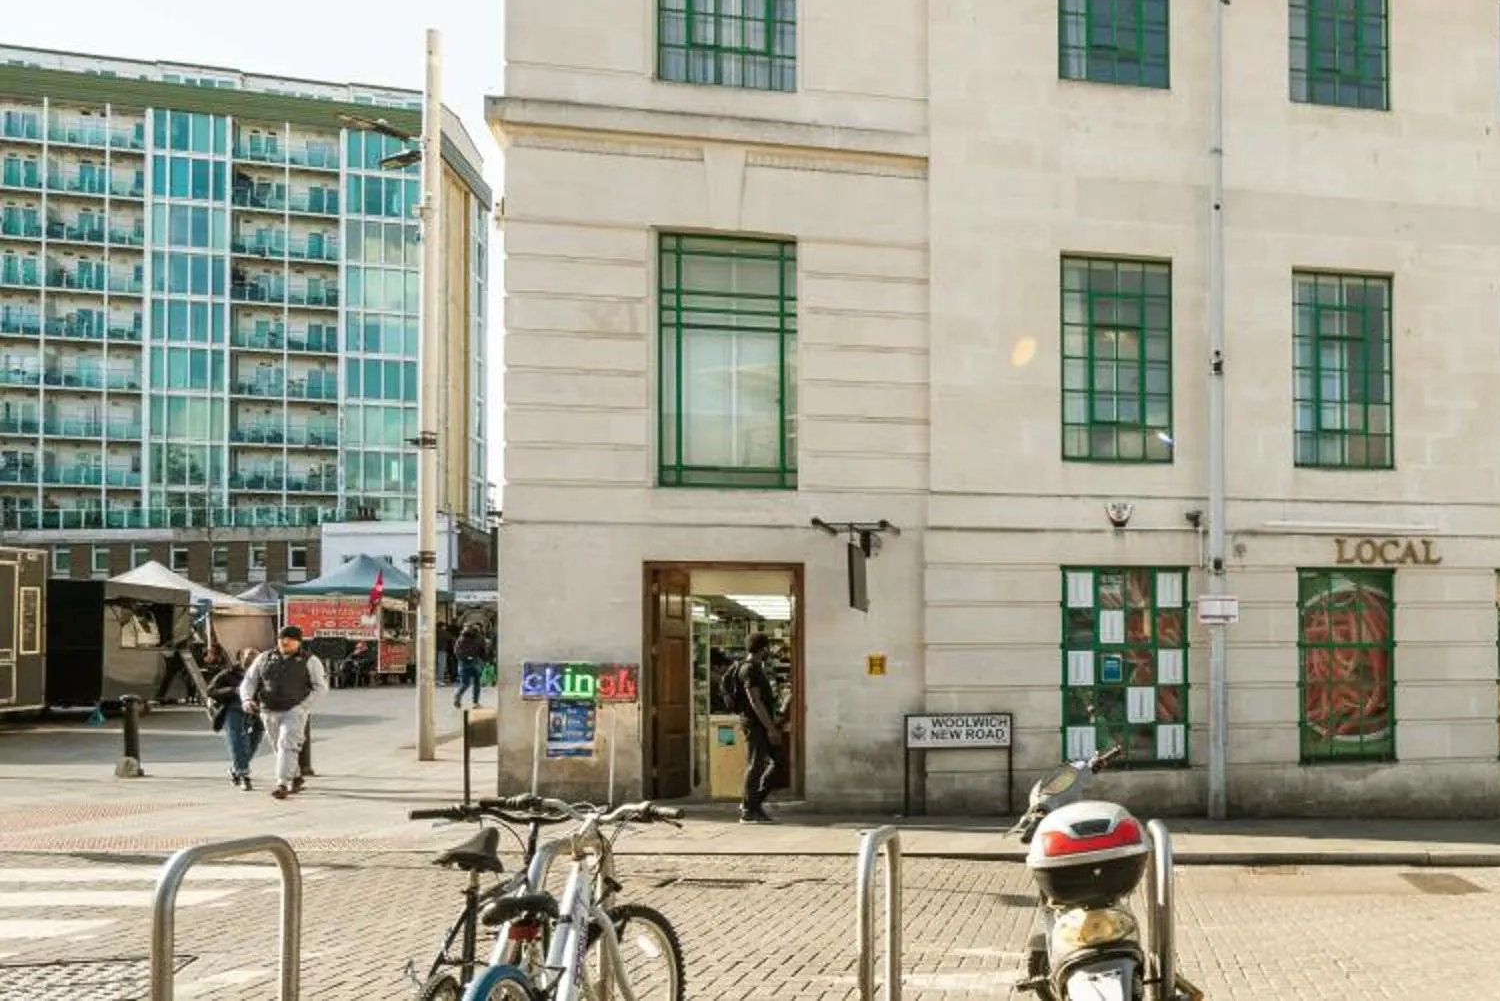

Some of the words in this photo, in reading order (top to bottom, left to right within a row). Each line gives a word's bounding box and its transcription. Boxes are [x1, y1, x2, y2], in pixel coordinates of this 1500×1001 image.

[1334, 537, 1443, 564] LOCAL
[931, 716, 1008, 728] WOOLWICH
[930, 729, 962, 741] NEW
[965, 728, 1006, 740] ROAD
